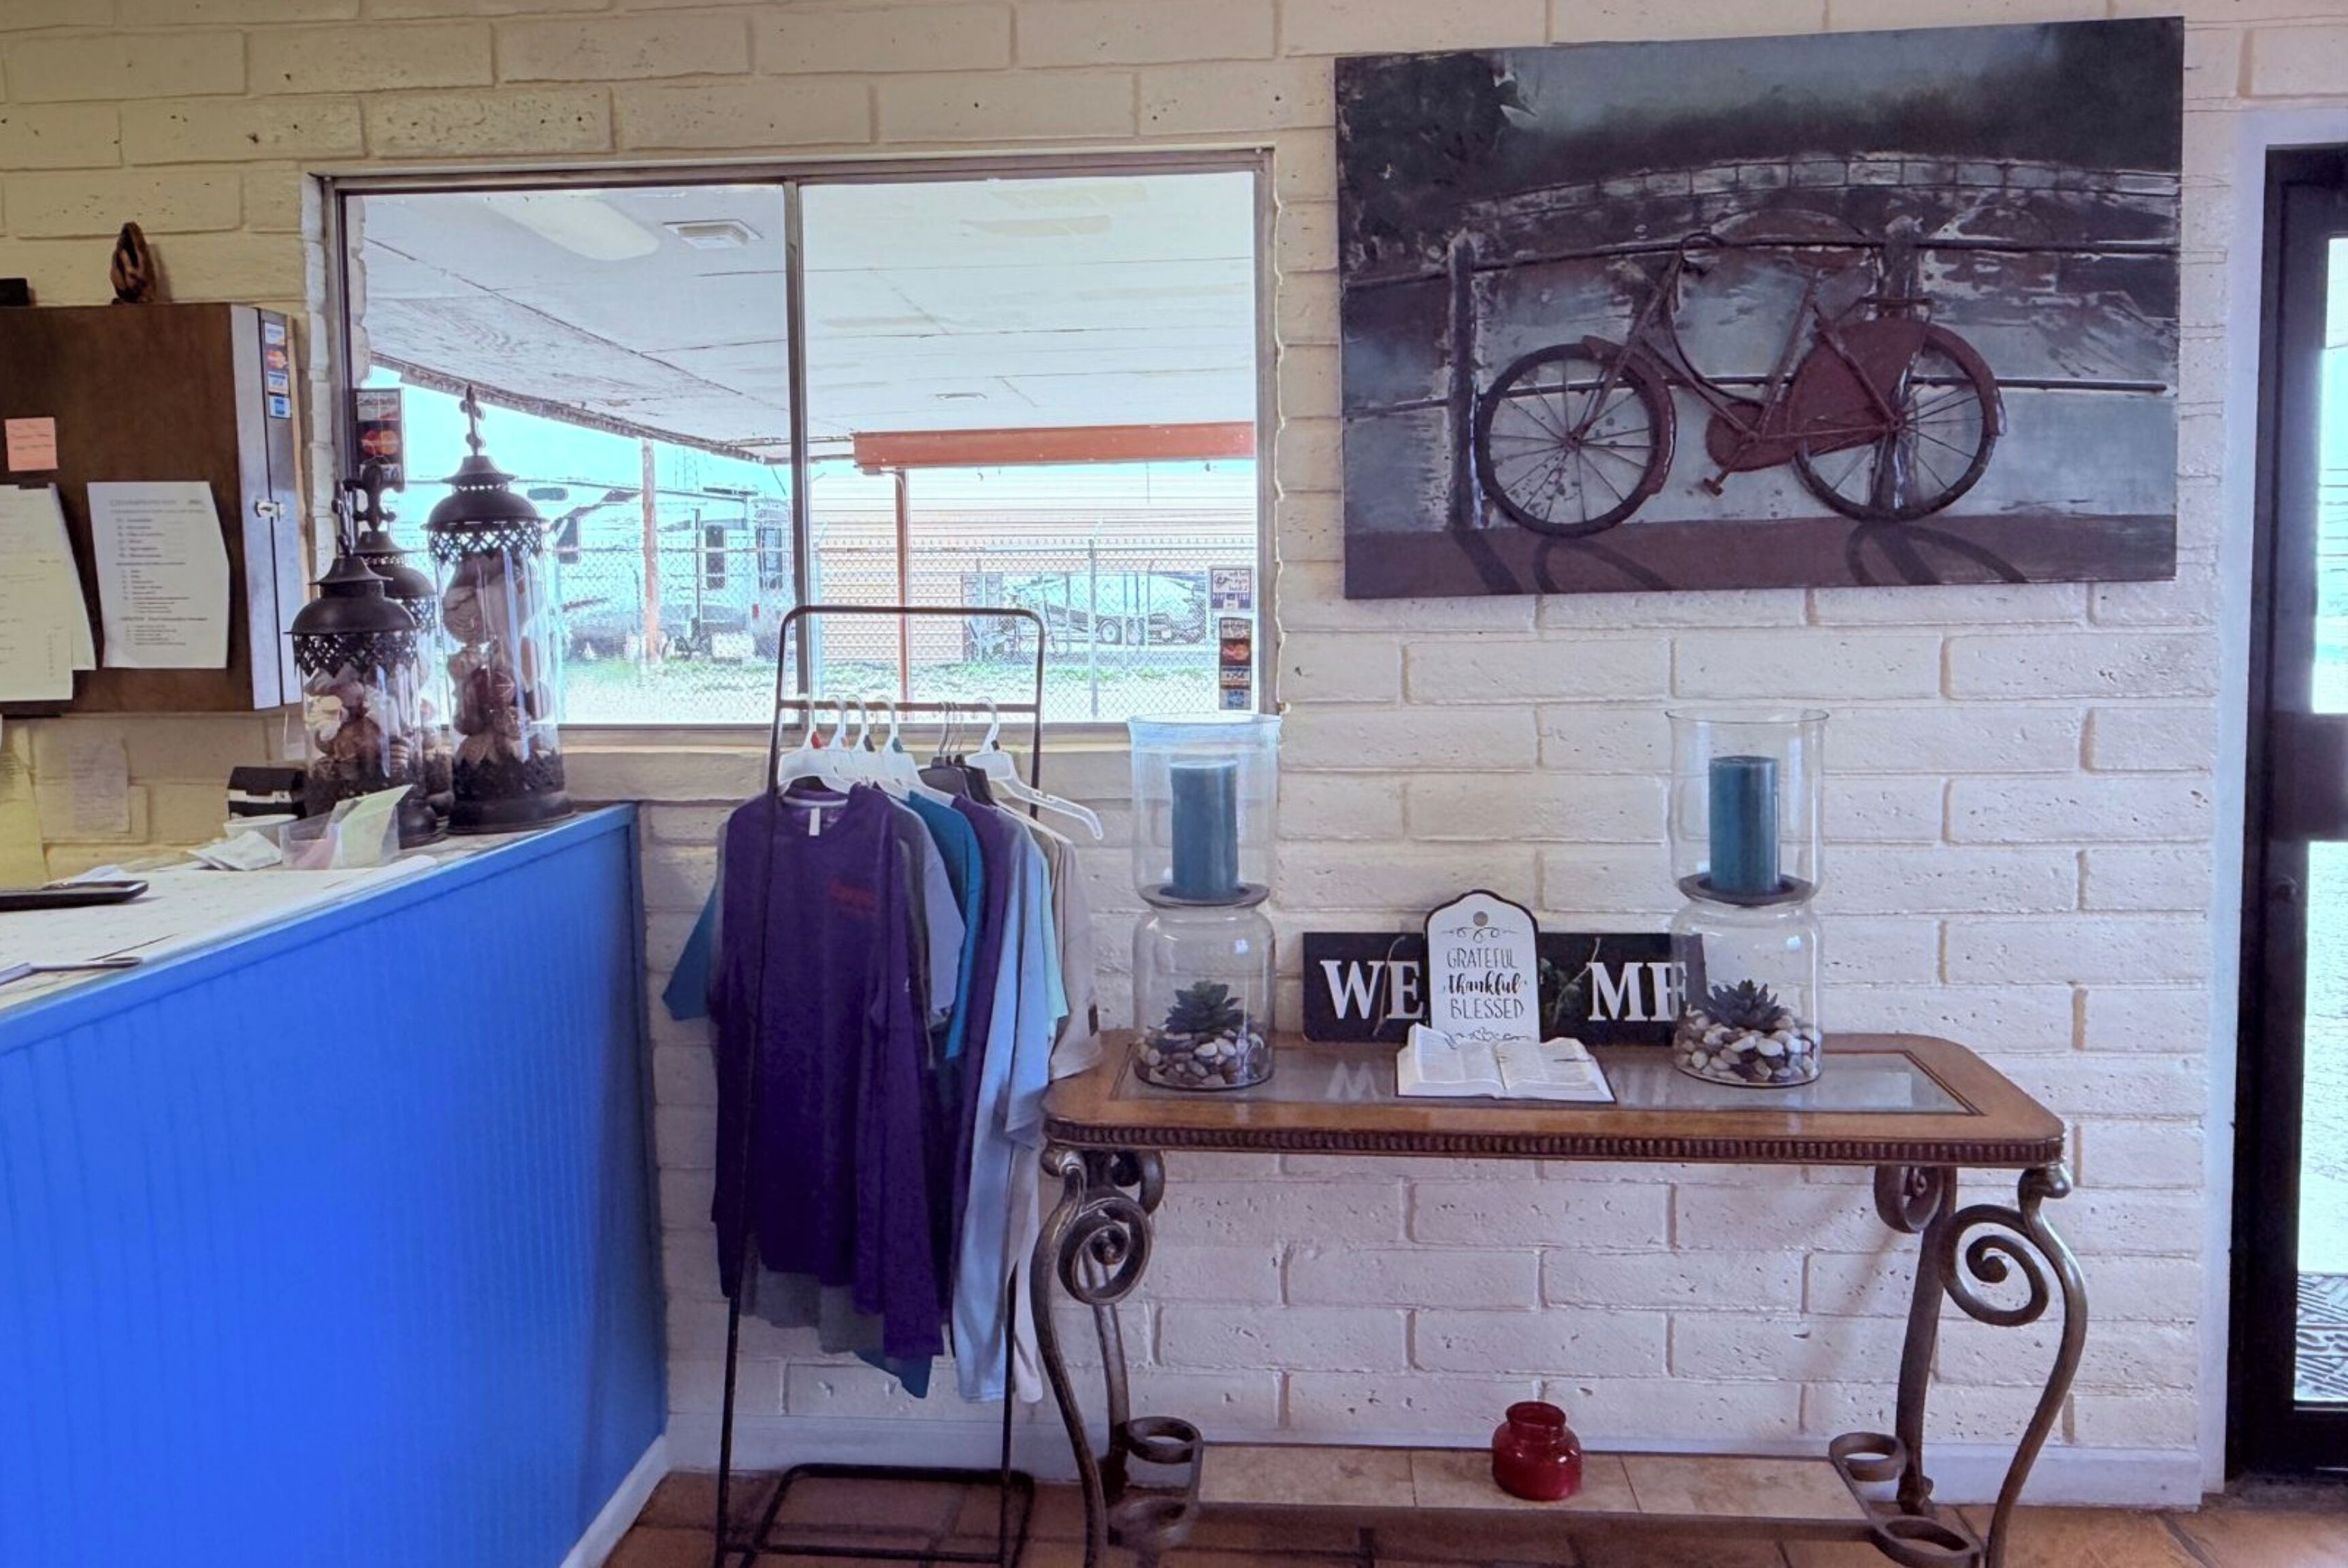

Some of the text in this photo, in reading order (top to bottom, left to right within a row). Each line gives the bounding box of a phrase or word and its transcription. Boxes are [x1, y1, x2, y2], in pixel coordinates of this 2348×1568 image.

[1447, 948, 1517, 968] GRATEFUL
[1448, 971, 1522, 995] thankful
[1450, 998, 1524, 1019] BLESSED
